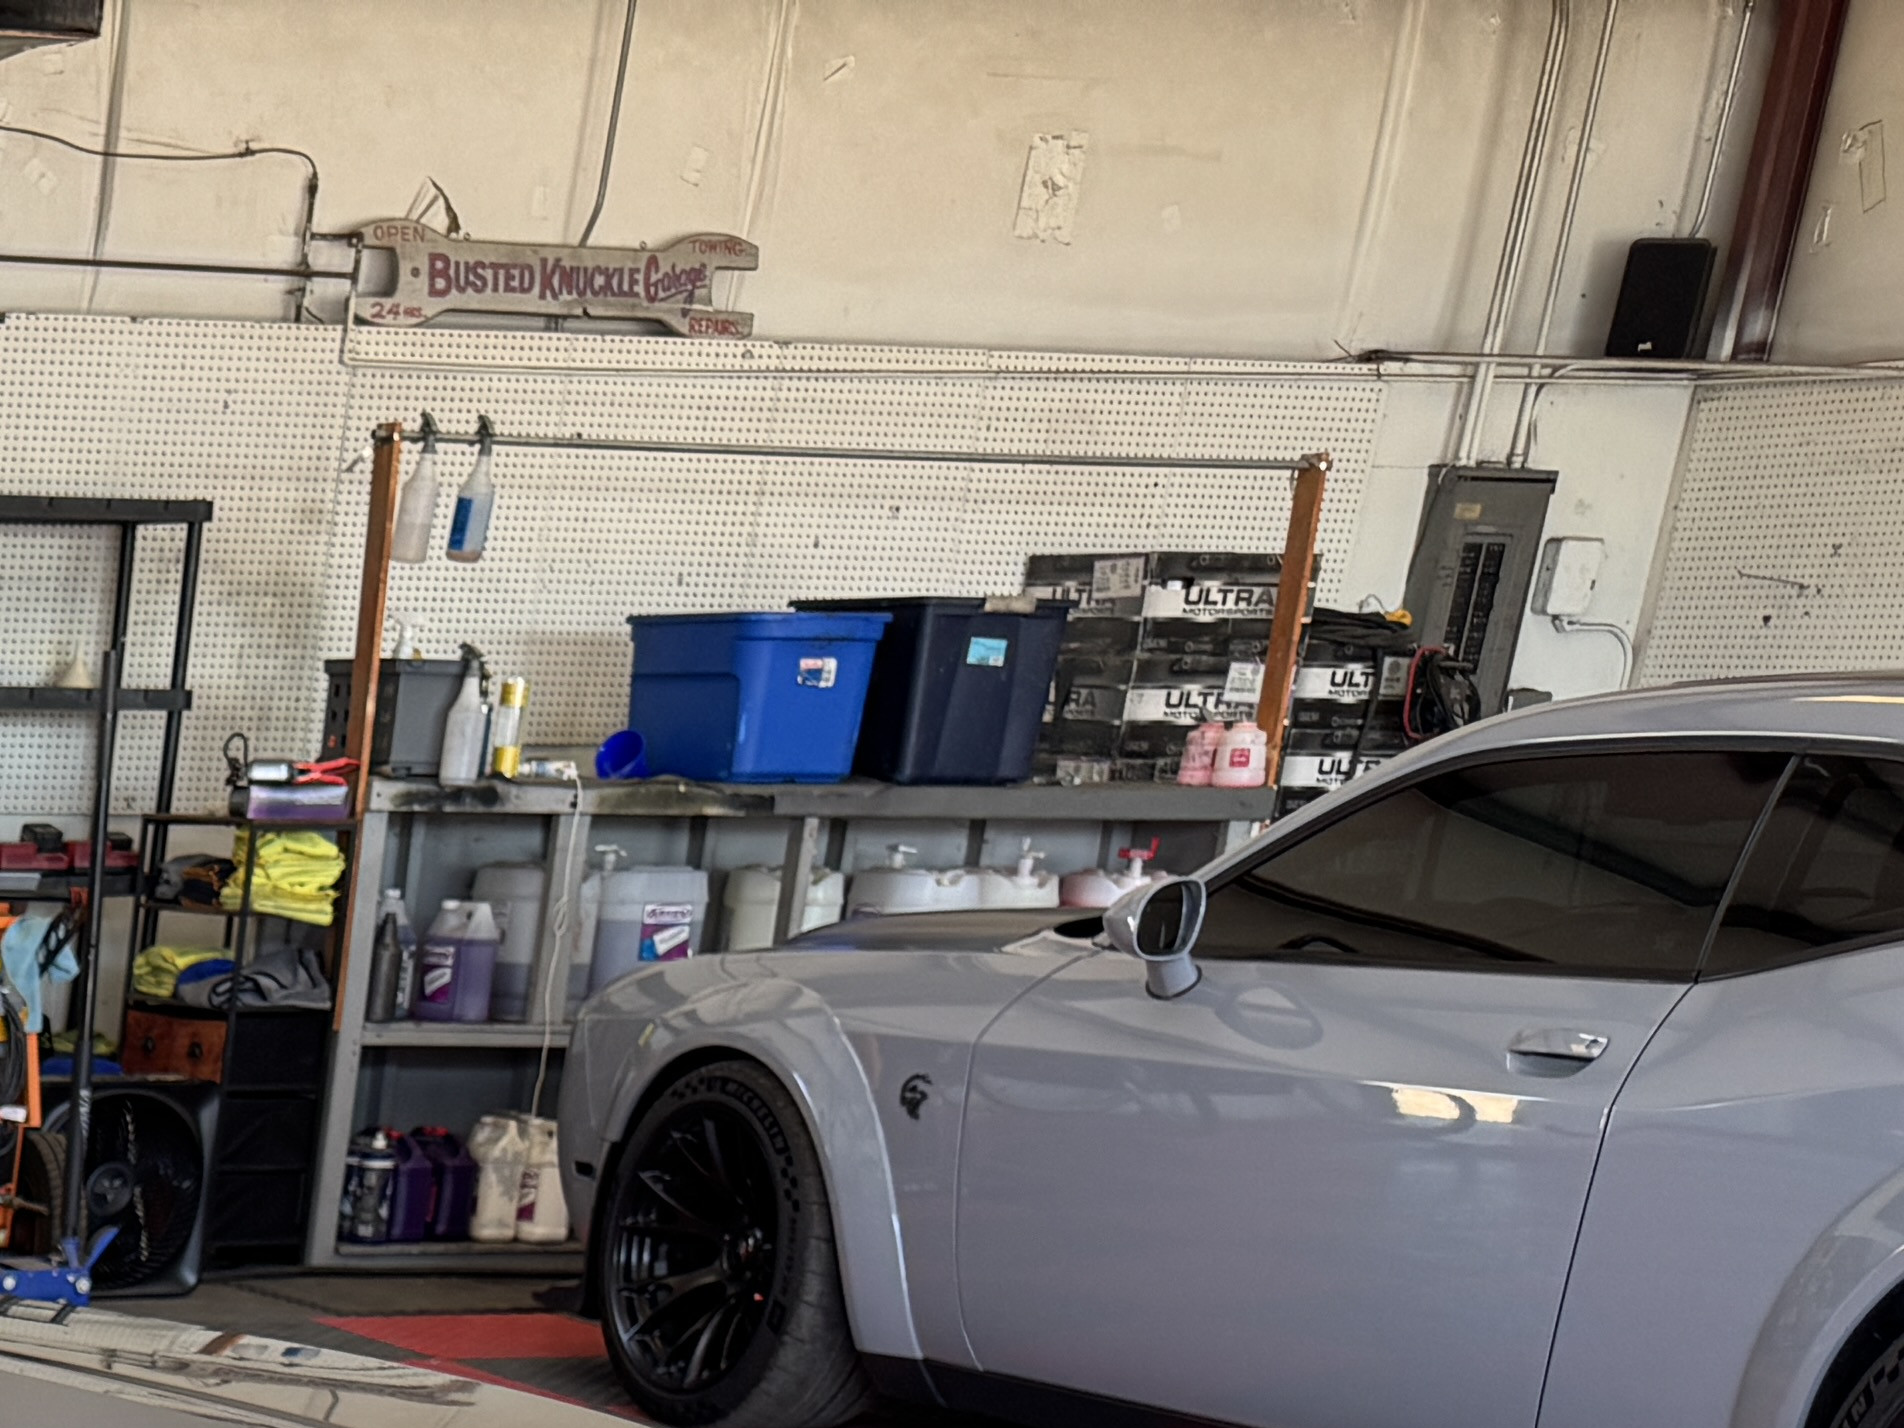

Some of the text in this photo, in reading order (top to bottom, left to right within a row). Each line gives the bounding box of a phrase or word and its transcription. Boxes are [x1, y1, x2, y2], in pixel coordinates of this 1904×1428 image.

[373, 224, 425, 243] OPEN
[689, 239, 745, 256] TOWING
[428, 252, 535, 299] BUSTED
[539, 257, 641, 301] KNUCKLE
[370, 302, 401, 320] 24
[1184, 586, 1275, 609] ULTRA
